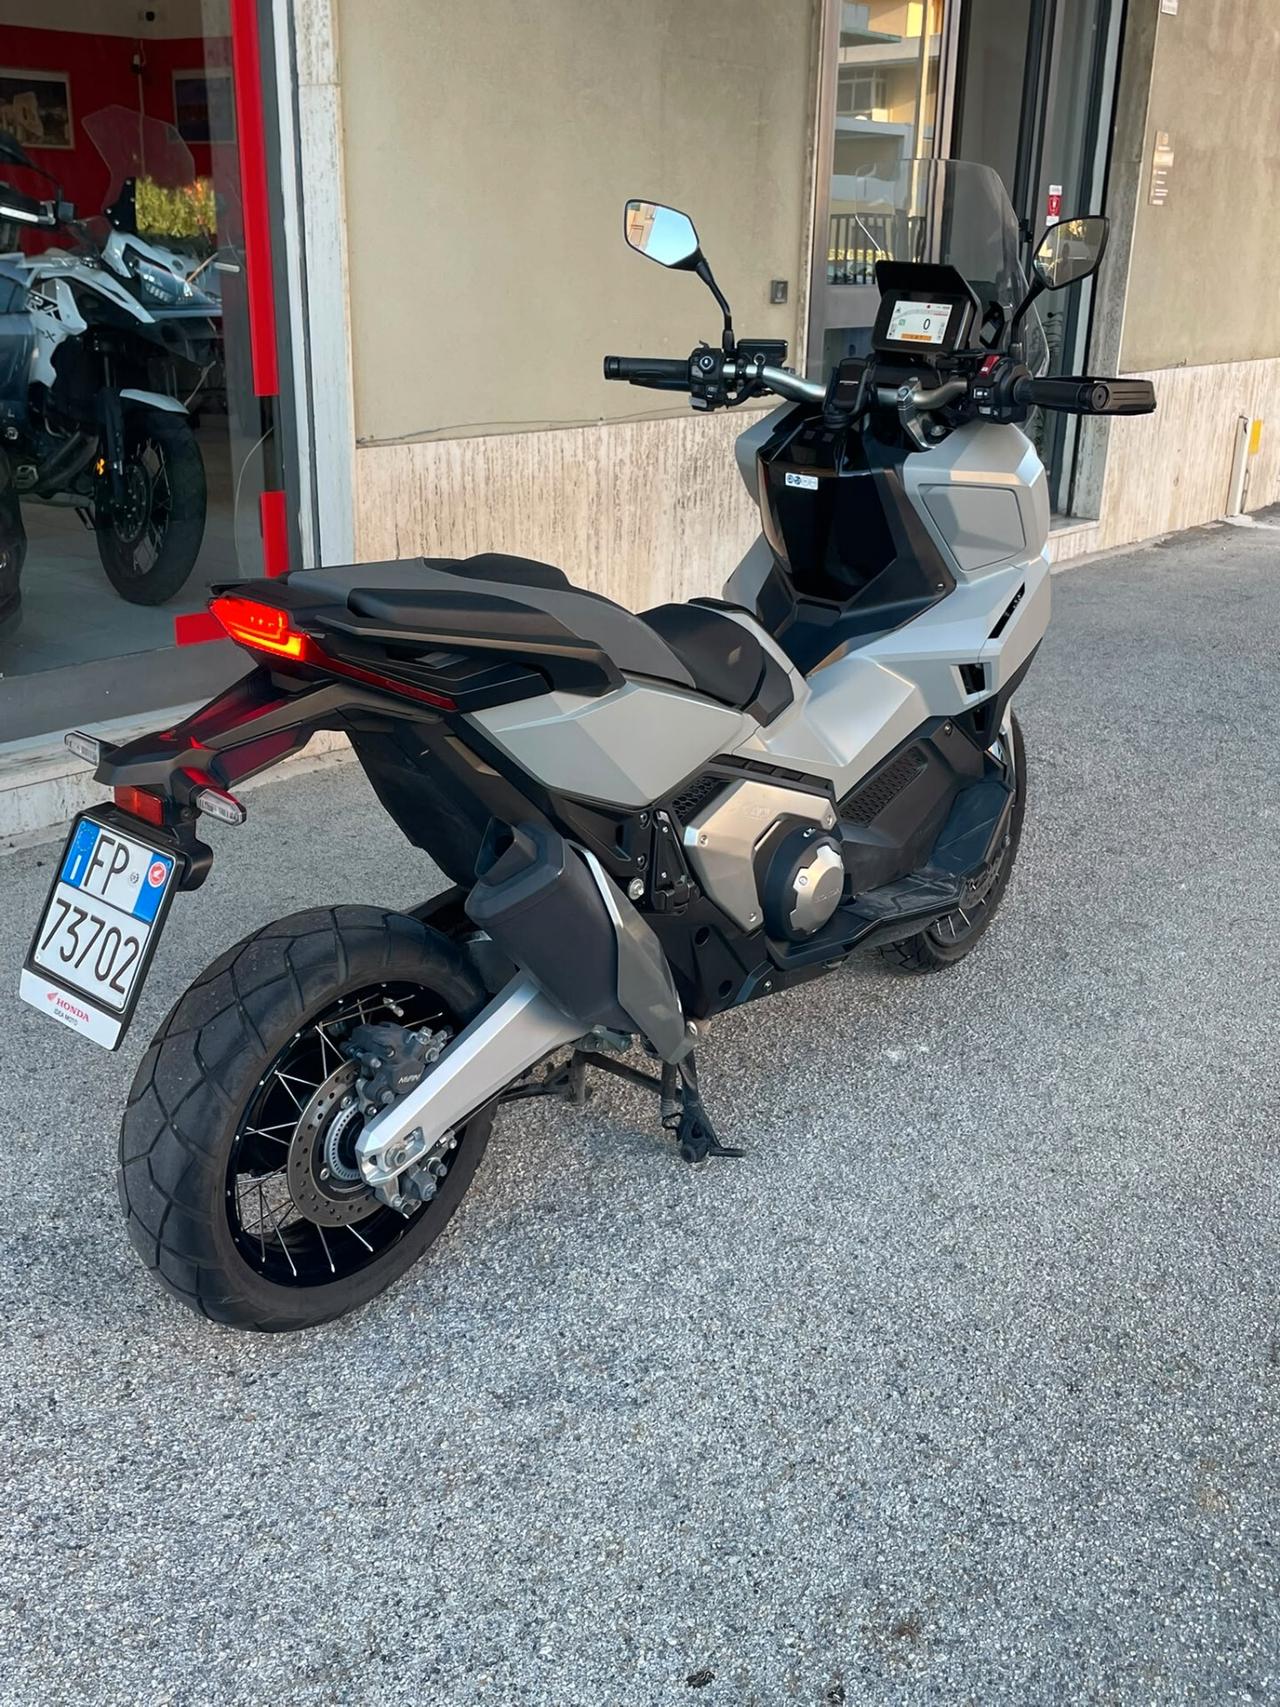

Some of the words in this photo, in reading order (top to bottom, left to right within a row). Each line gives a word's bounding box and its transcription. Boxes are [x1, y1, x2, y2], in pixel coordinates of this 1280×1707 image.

[923, 318, 931, 330] 0
[84, 834, 130, 895] FP
[41, 898, 140, 995] 73702
[56, 998, 90, 1022] HONDA
